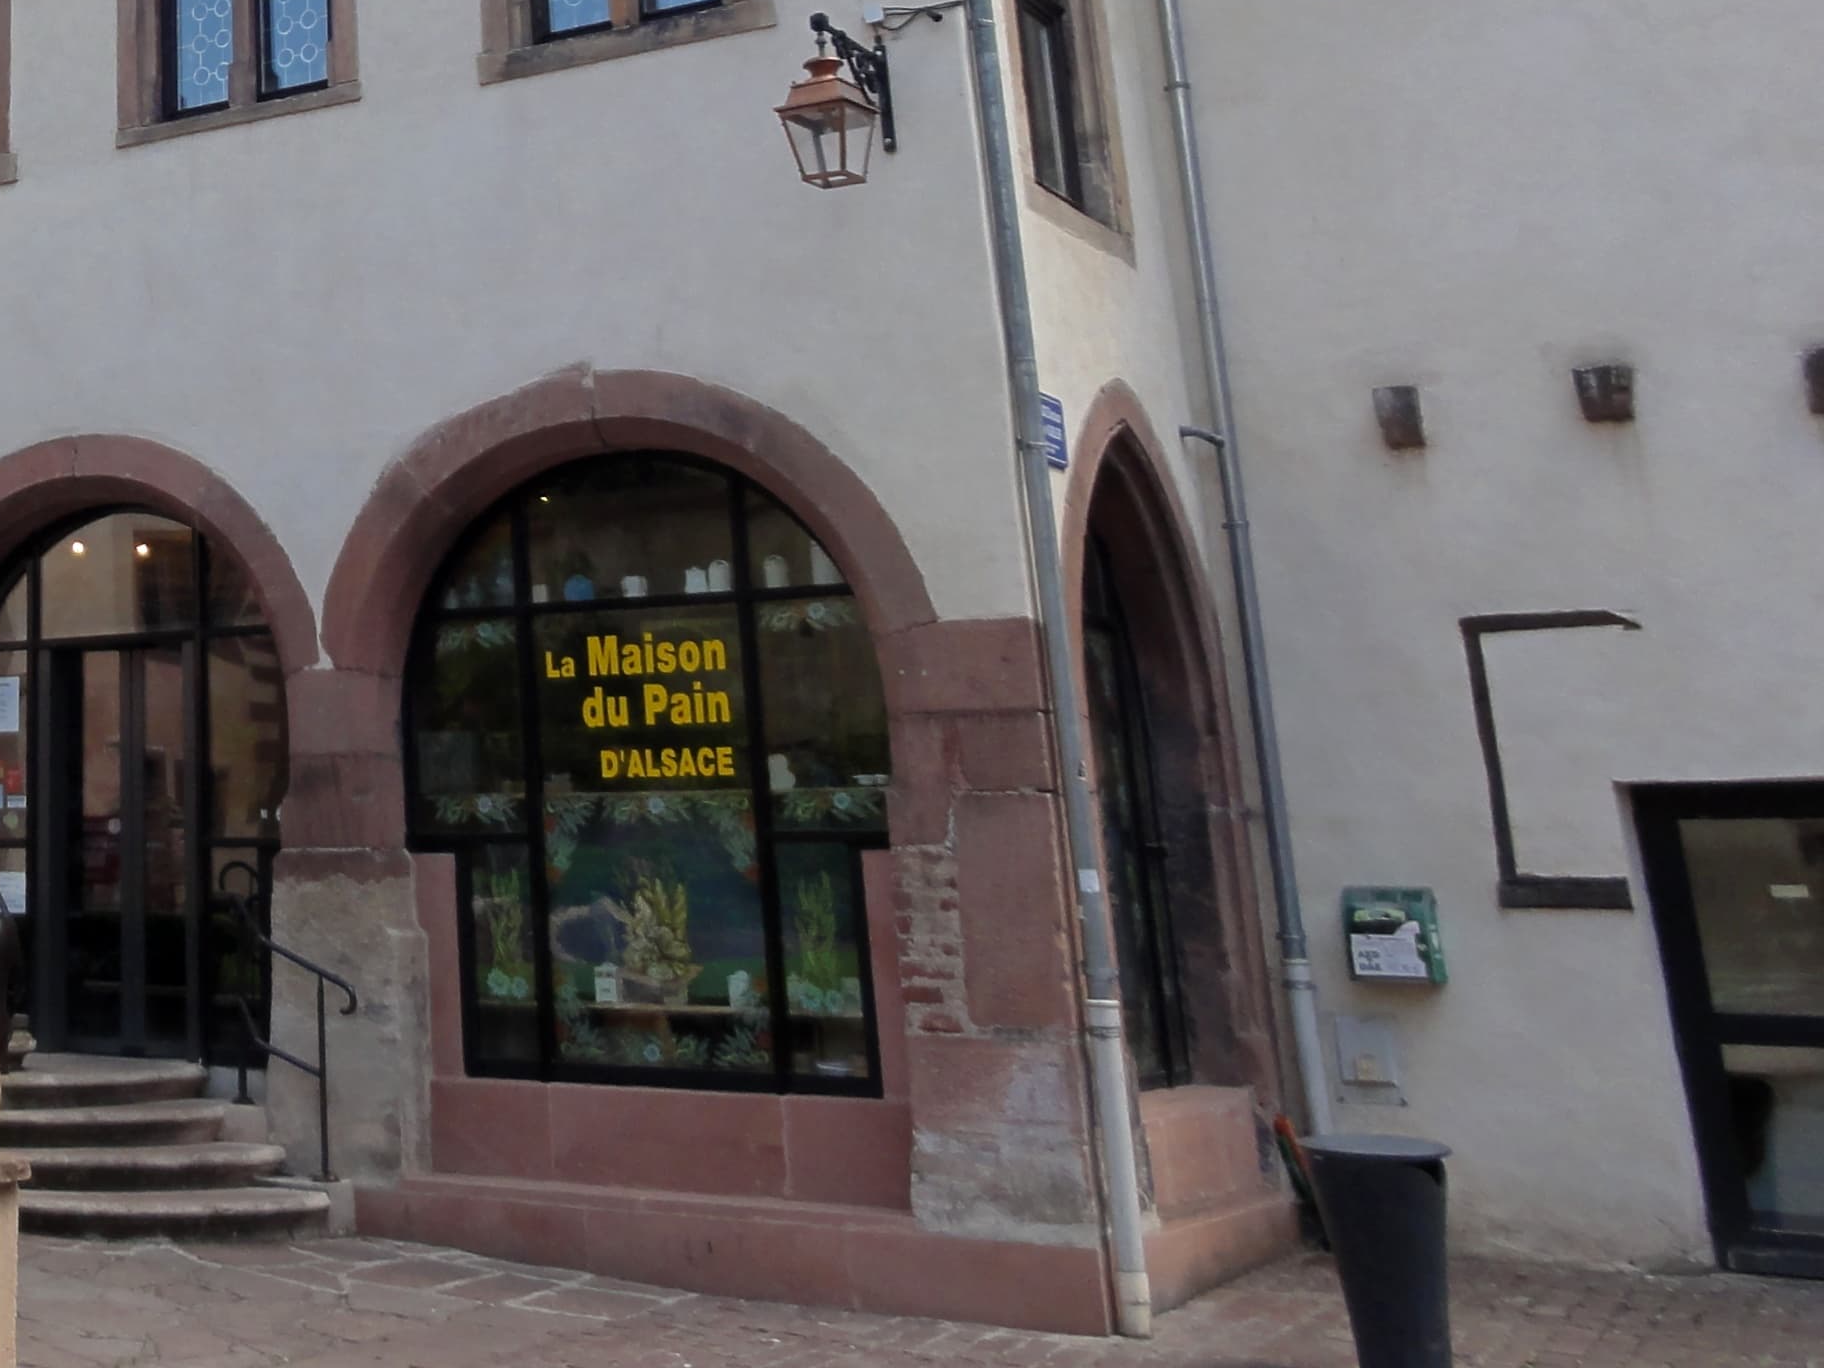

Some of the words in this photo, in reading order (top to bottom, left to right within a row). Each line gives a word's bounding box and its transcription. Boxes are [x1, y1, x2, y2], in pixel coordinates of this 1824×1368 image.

[545, 651, 575, 678] La
[587, 632, 726, 676] Maison
[582, 687, 629, 728] du
[643, 681, 730, 725] Pain
[600, 747, 735, 778] D'ALSACE
